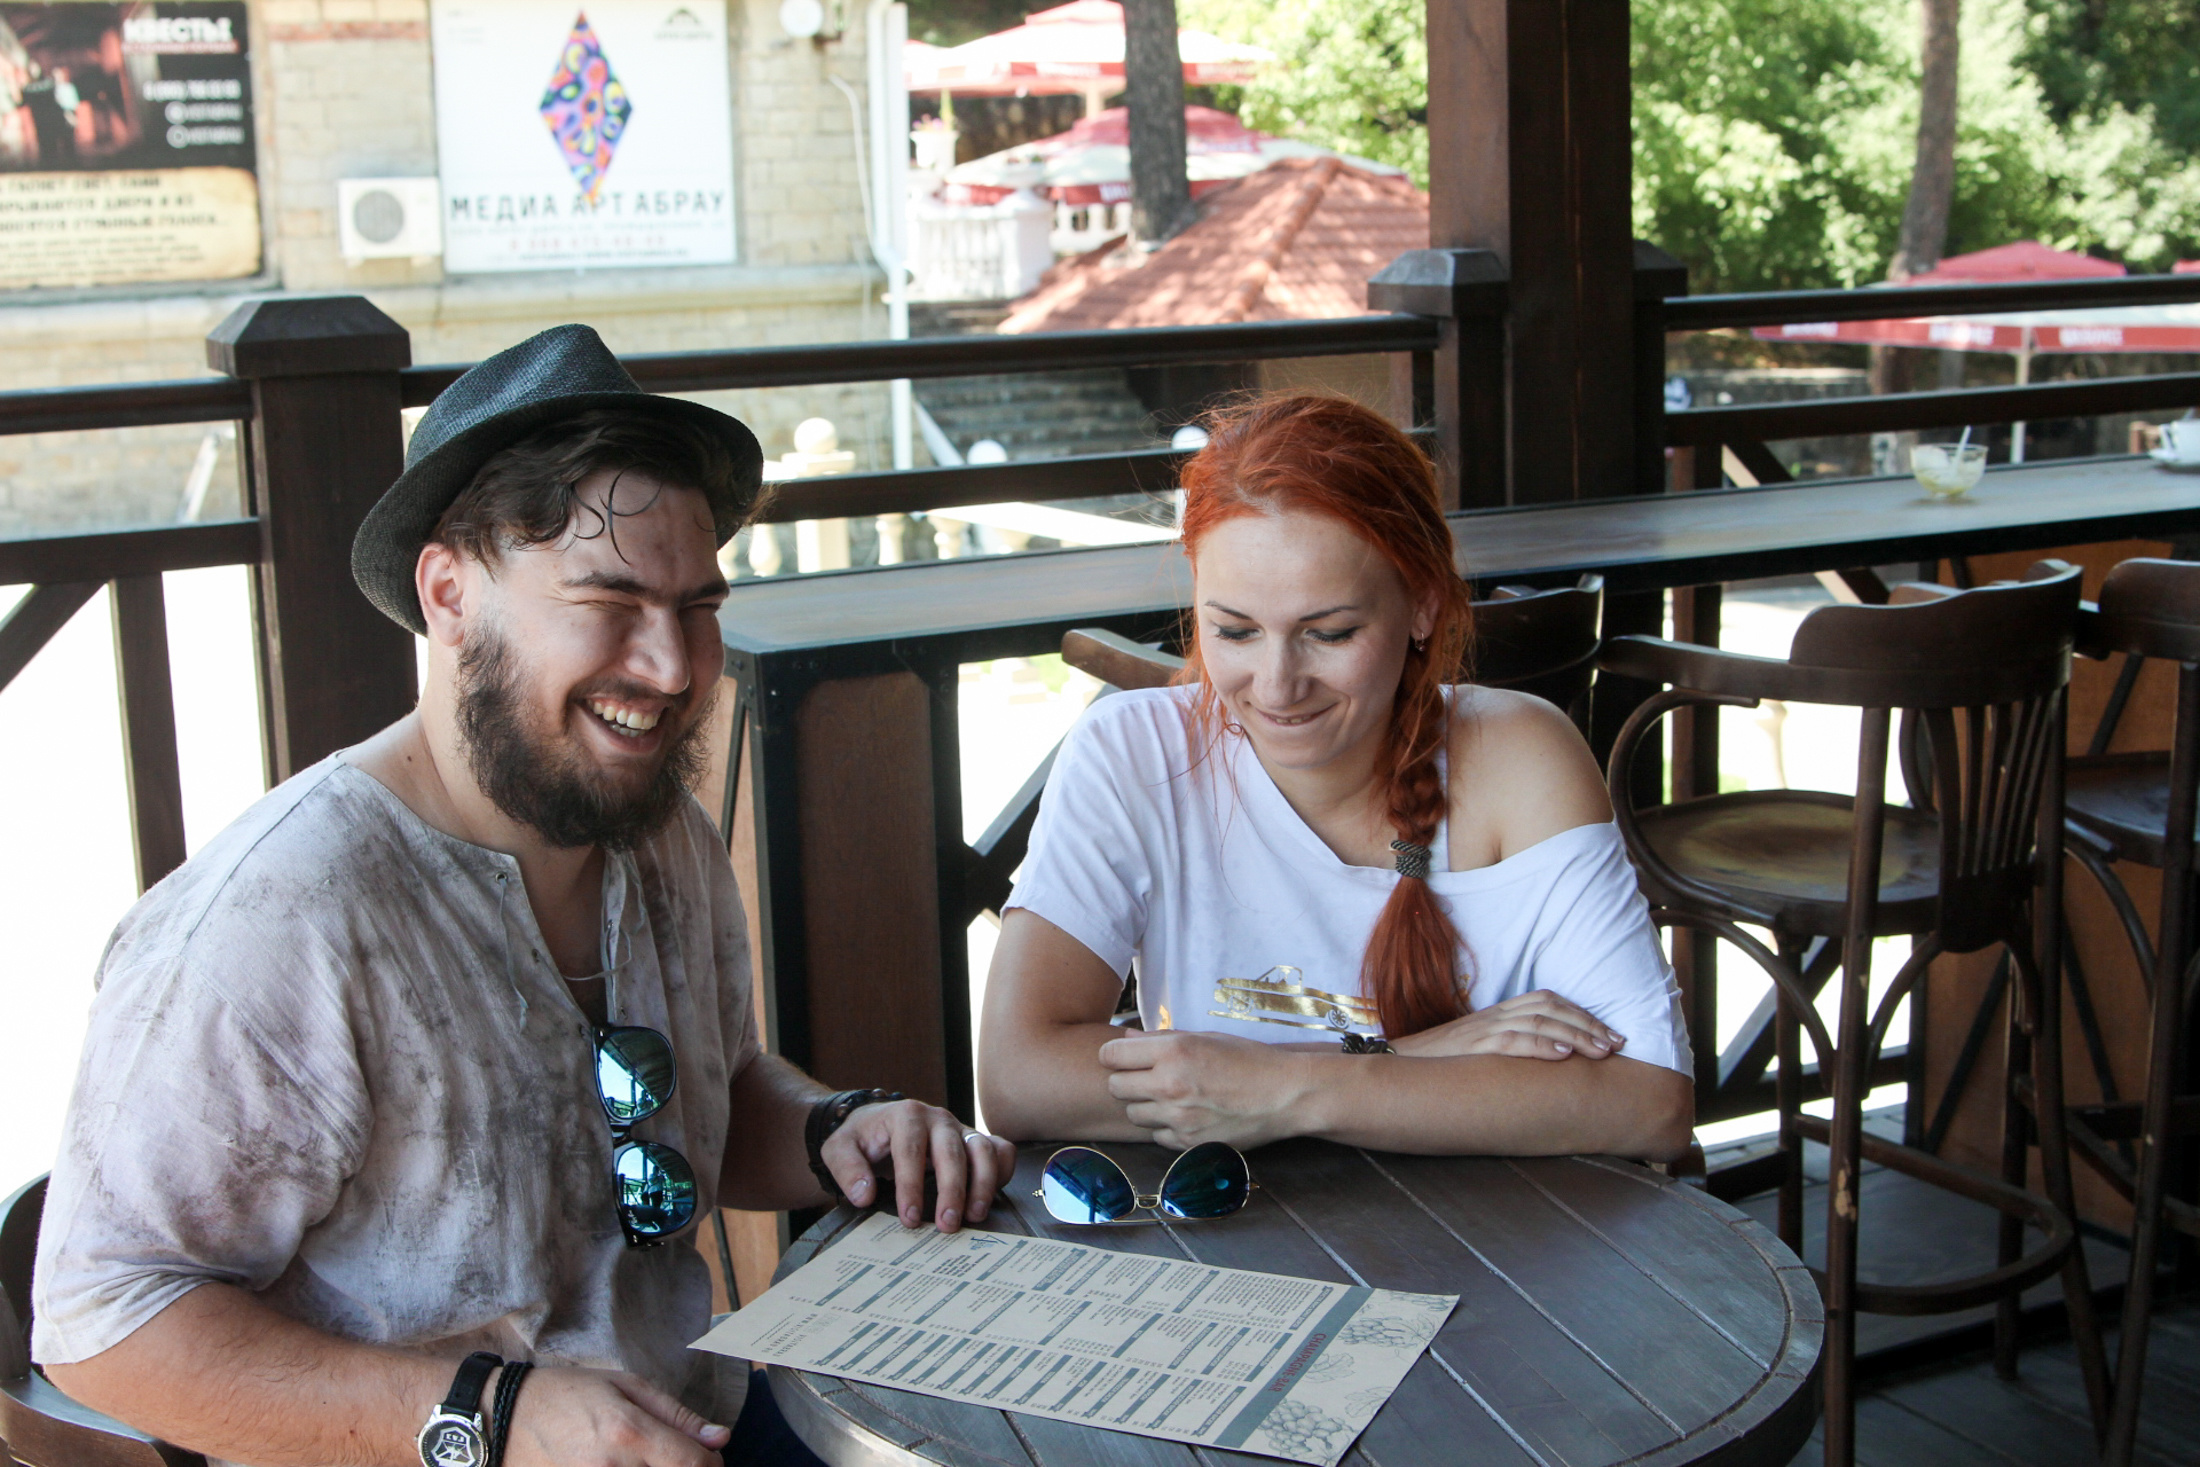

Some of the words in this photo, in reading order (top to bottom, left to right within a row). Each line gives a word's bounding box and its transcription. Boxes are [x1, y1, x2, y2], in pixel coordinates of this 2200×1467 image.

[451, 193, 558, 222] МЕДИА
[571, 192, 625, 217] АРТ
[634, 189, 725, 215] АБРАУ
[1268, 1333, 1327, 1392] CHAMPAGNE-BAR
